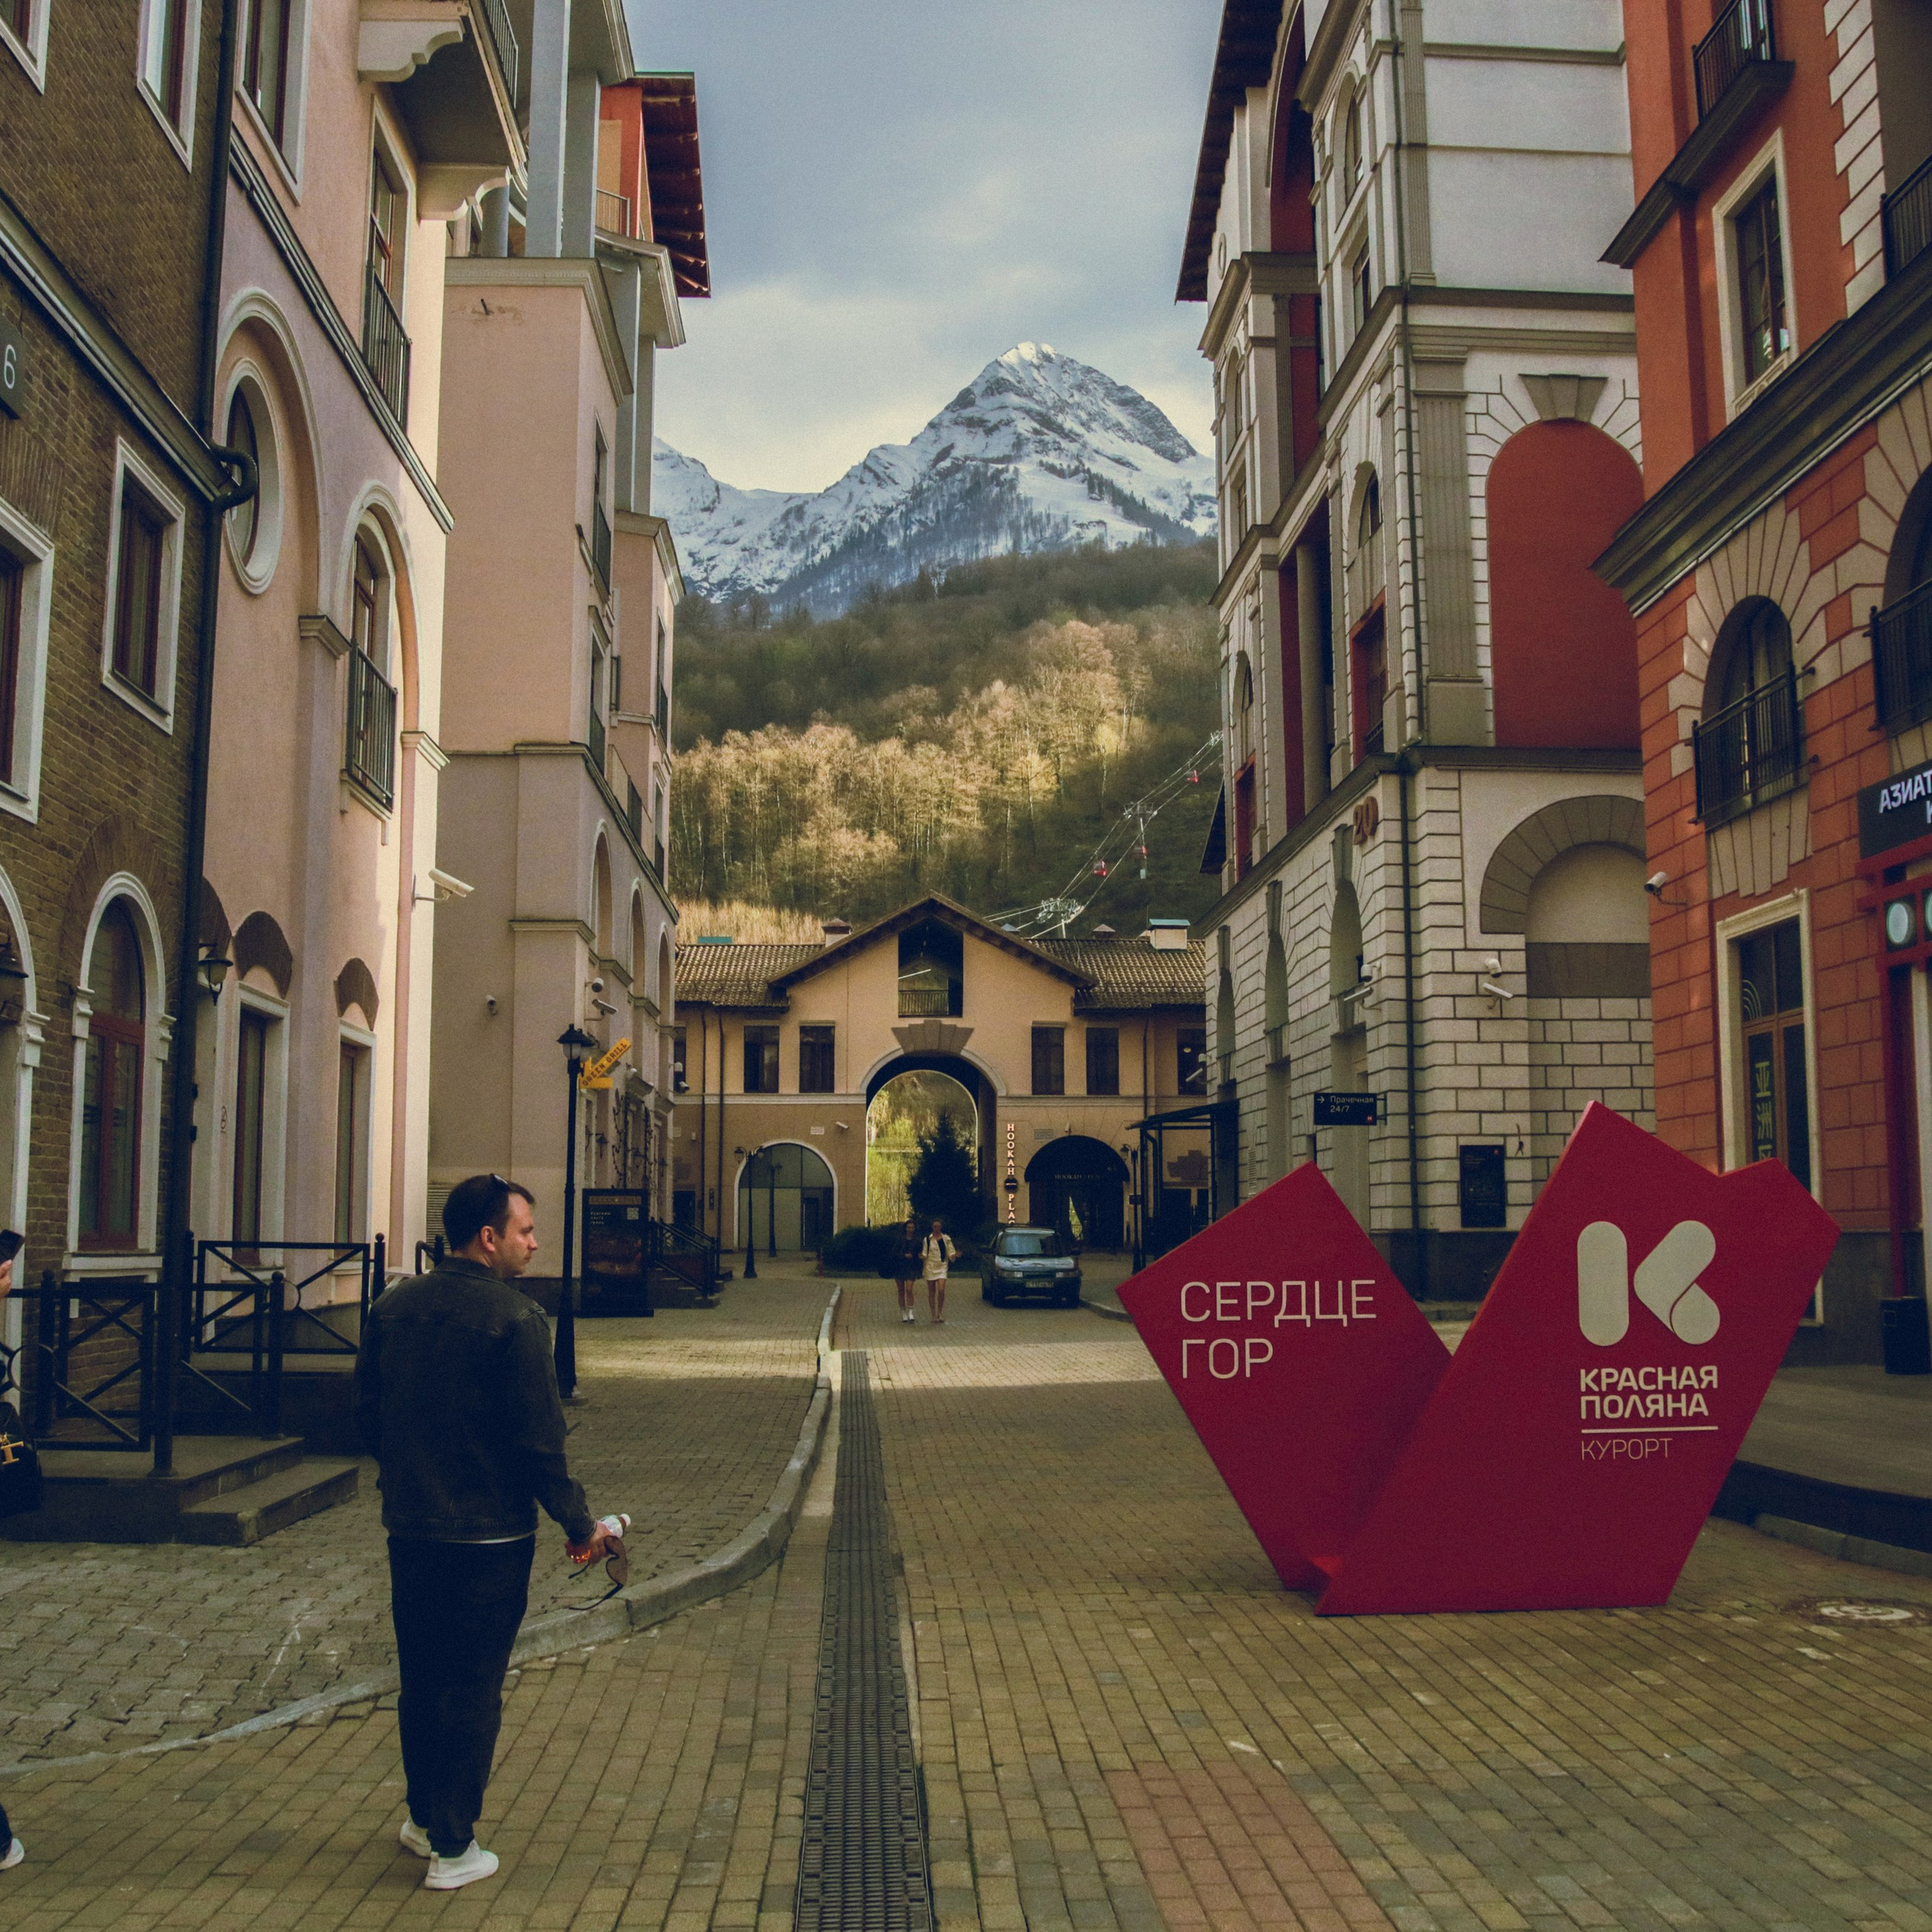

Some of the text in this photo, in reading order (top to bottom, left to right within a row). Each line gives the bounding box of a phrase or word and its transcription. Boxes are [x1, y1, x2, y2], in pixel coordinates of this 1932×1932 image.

[3, 343, 17, 390] 6
[1353, 795, 1379, 845] 20
[582, 1042, 627, 1086] GREEN GRILL
[1330, 1095, 1374, 1105] Прачечная
[1330, 1105, 1350, 1113] 24/7
[1006, 1123, 1016, 1224] HOOKAH PLA
[1180, 1279, 1377, 1328] СЕРДЦЕ
[1182, 1338, 1274, 1380] ГОР
[1580, 1365, 1718, 1392] КРАСНАЯ
[1580, 1393, 1709, 1420] ПОЛЯНА
[1581, 1438, 1673, 1460] КУРОРТ
